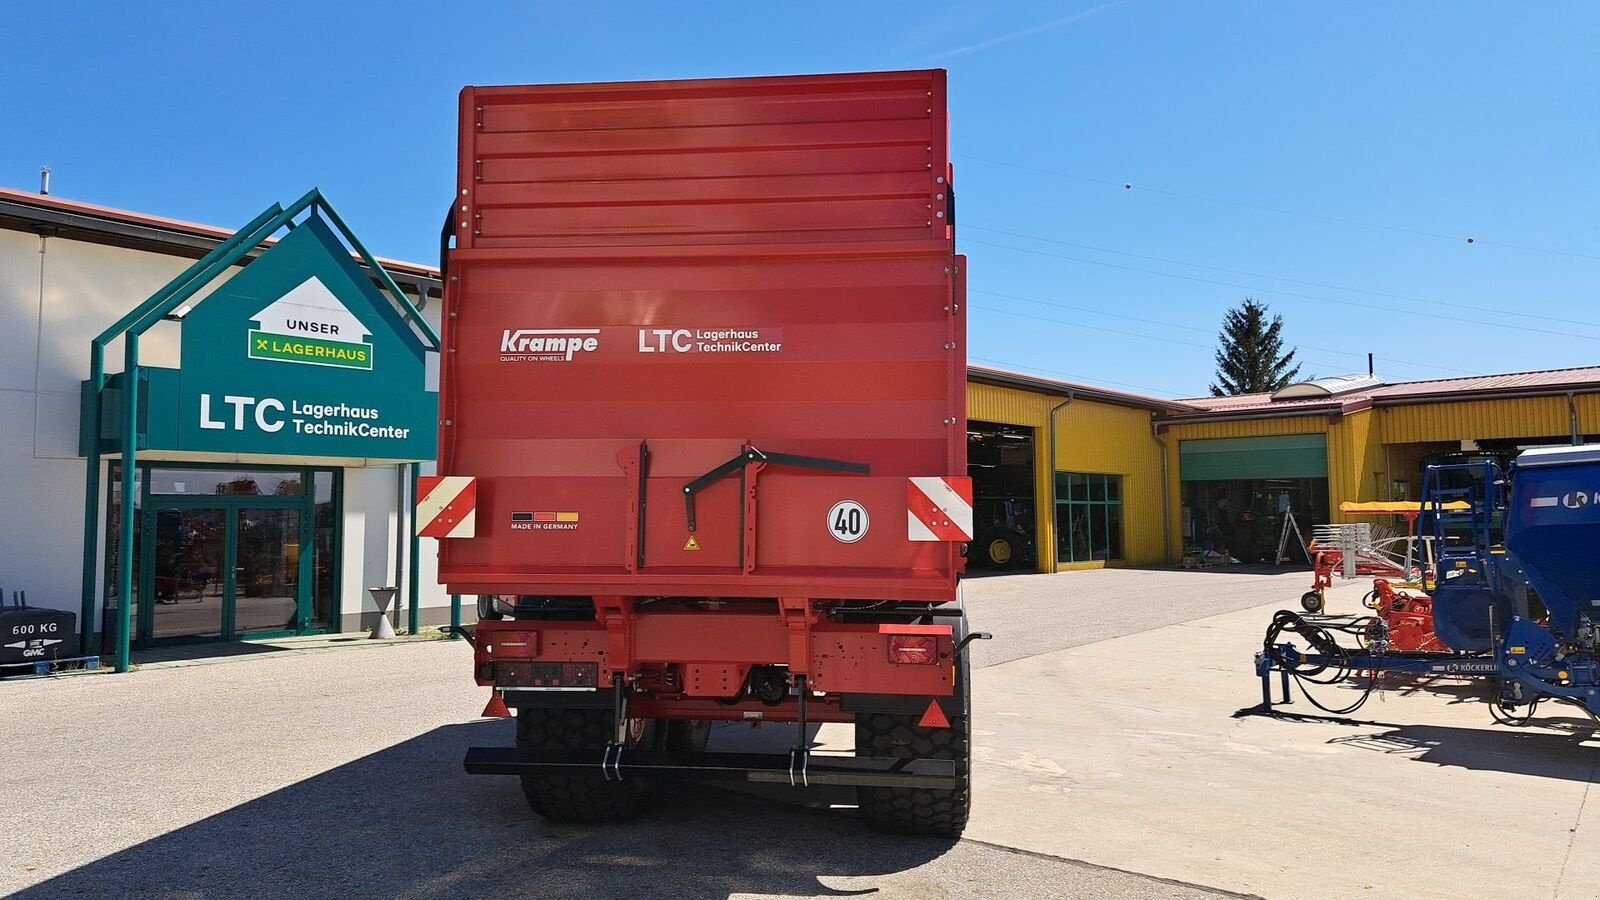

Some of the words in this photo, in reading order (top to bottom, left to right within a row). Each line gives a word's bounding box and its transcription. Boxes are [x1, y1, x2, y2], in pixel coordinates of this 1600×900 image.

[286, 319, 339, 335] UNSER
[696, 329, 759, 341] Lagerhaus
[500, 329, 600, 361] Krampe
[639, 329, 692, 353] LTC
[696, 341, 782, 352] TechnikCenter
[272, 341, 366, 361] LAGERHAUS
[200, 393, 285, 433] LTC
[292, 400, 379, 419] Lagerhaus
[292, 419, 410, 439] TechnikCenter
[834, 508, 861, 535] 40
[12, 624, 35, 635] 600
[40, 623, 57, 633] KG
[23, 648, 45, 657] GMC
